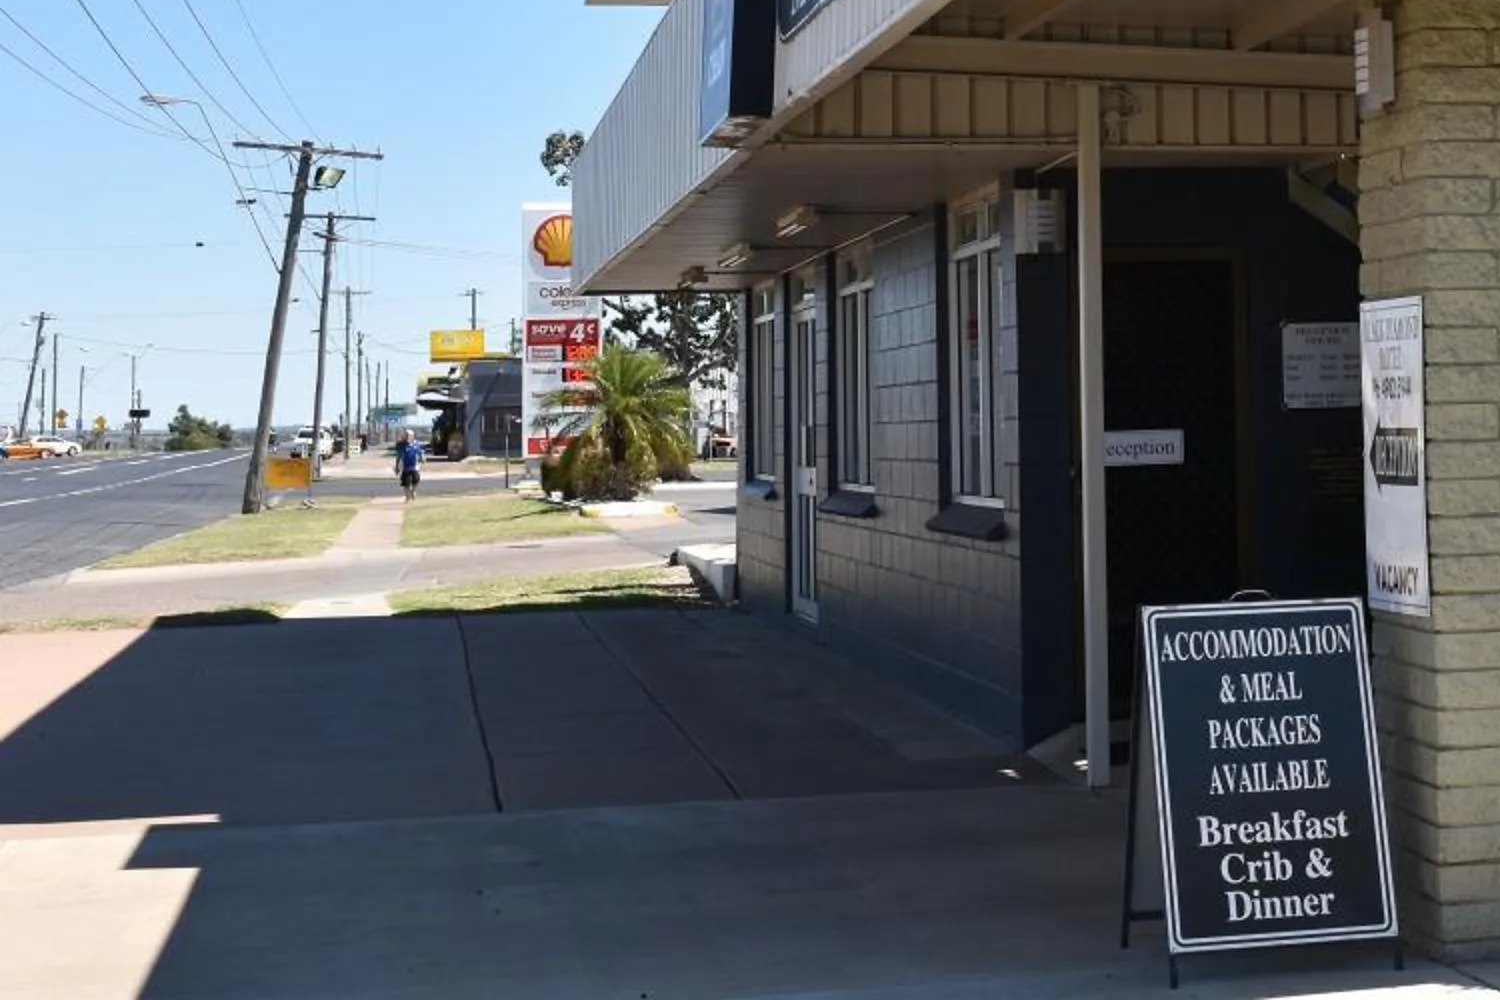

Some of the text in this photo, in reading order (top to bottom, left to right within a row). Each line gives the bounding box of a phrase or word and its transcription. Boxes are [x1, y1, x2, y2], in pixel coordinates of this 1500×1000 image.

[531, 323, 567, 336] save
[1105, 441, 1175, 460] eception
[1374, 562, 1419, 596] VACANCY
[1161, 623, 1353, 662] ACCOMMODATION
[1219, 671, 1303, 704] & MEAL
[1207, 713, 1321, 750] PACKAGES
[1208, 758, 1331, 795] AVAILABLE
[1197, 810, 1349, 847] Breakfast
[1220, 847, 1334, 884] Crib &
[1224, 889, 1335, 922] Dinner
